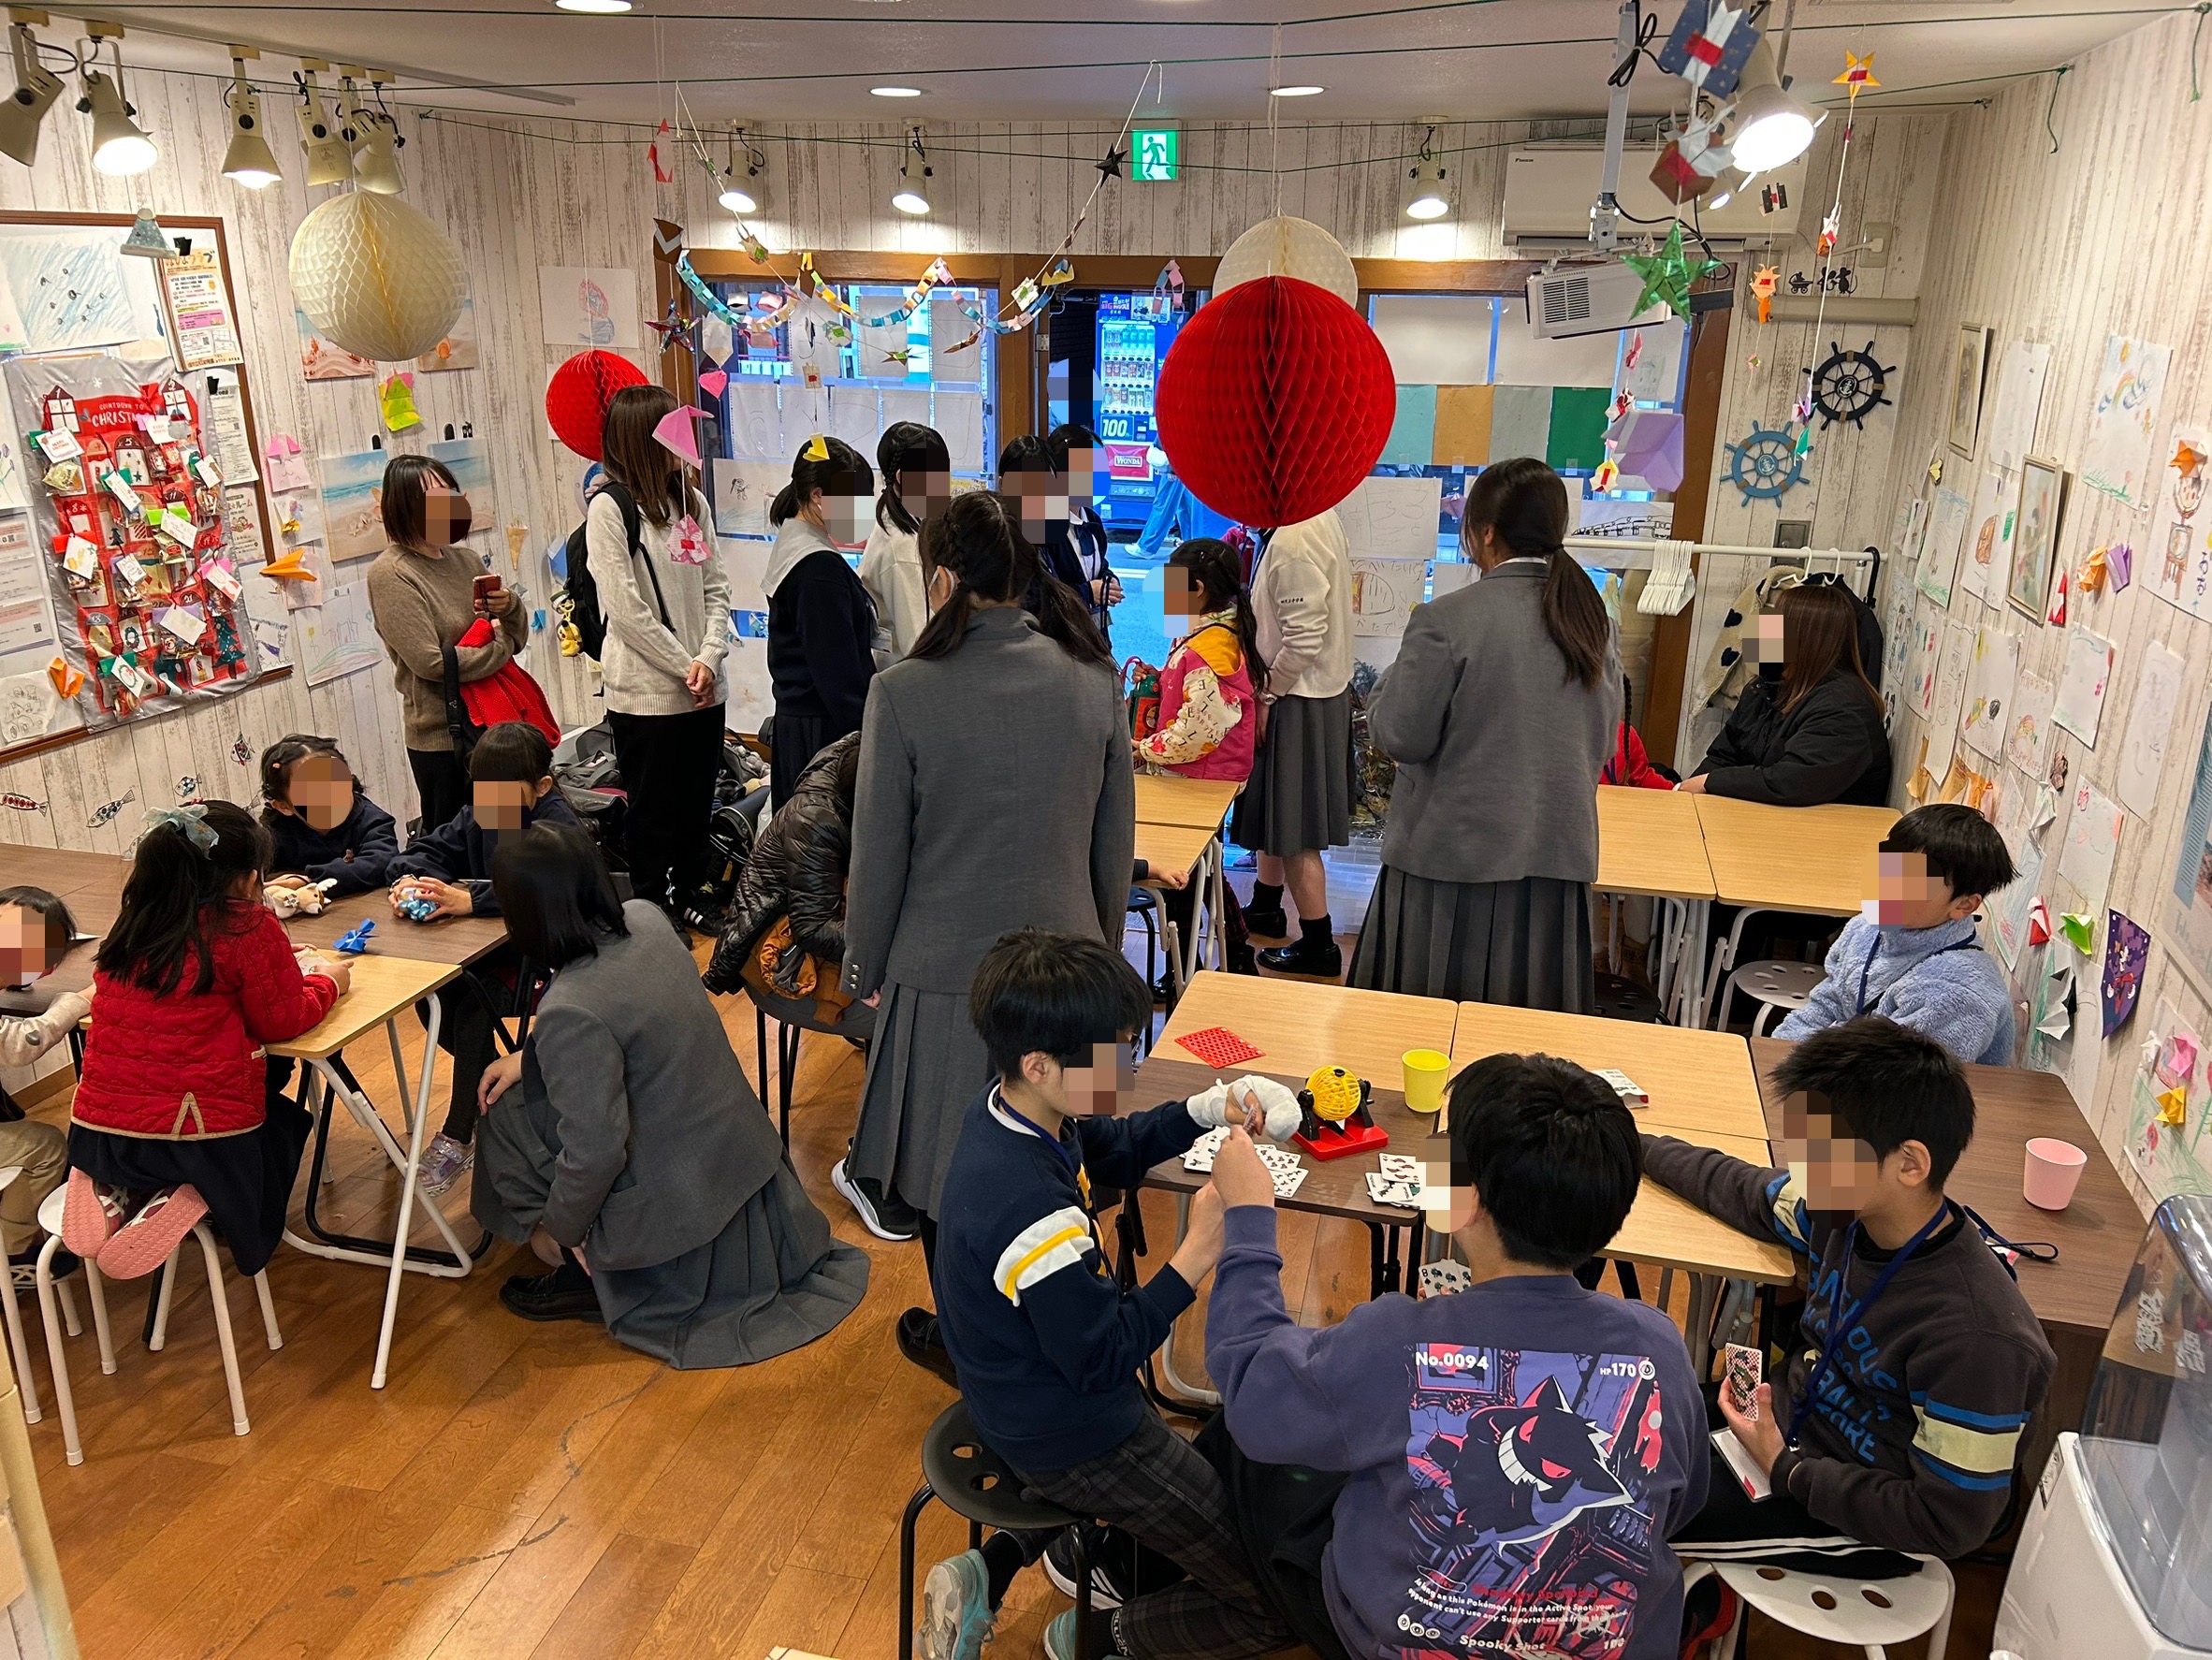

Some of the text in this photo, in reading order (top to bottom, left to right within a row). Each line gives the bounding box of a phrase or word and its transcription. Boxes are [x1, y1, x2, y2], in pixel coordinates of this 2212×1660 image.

[92, 410, 138, 428] CHRISTM
[1102, 418, 1128, 437] 100
[124, 437, 133, 446] 5
[1115, 456, 1141, 465] WONDA
[1421, 1268, 1429, 1277] 8
[1415, 1351, 1490, 1371] No.0094
[1437, 1593, 1448, 1601] as
[1448, 1594, 1465, 1605] this
[1529, 1603, 1544, 1613] the
[1444, 1605, 1465, 1615] can't
[1466, 1609, 1482, 1618] use
[1483, 1613, 1499, 1624] any
[1459, 1634, 1512, 1653] Spooky
